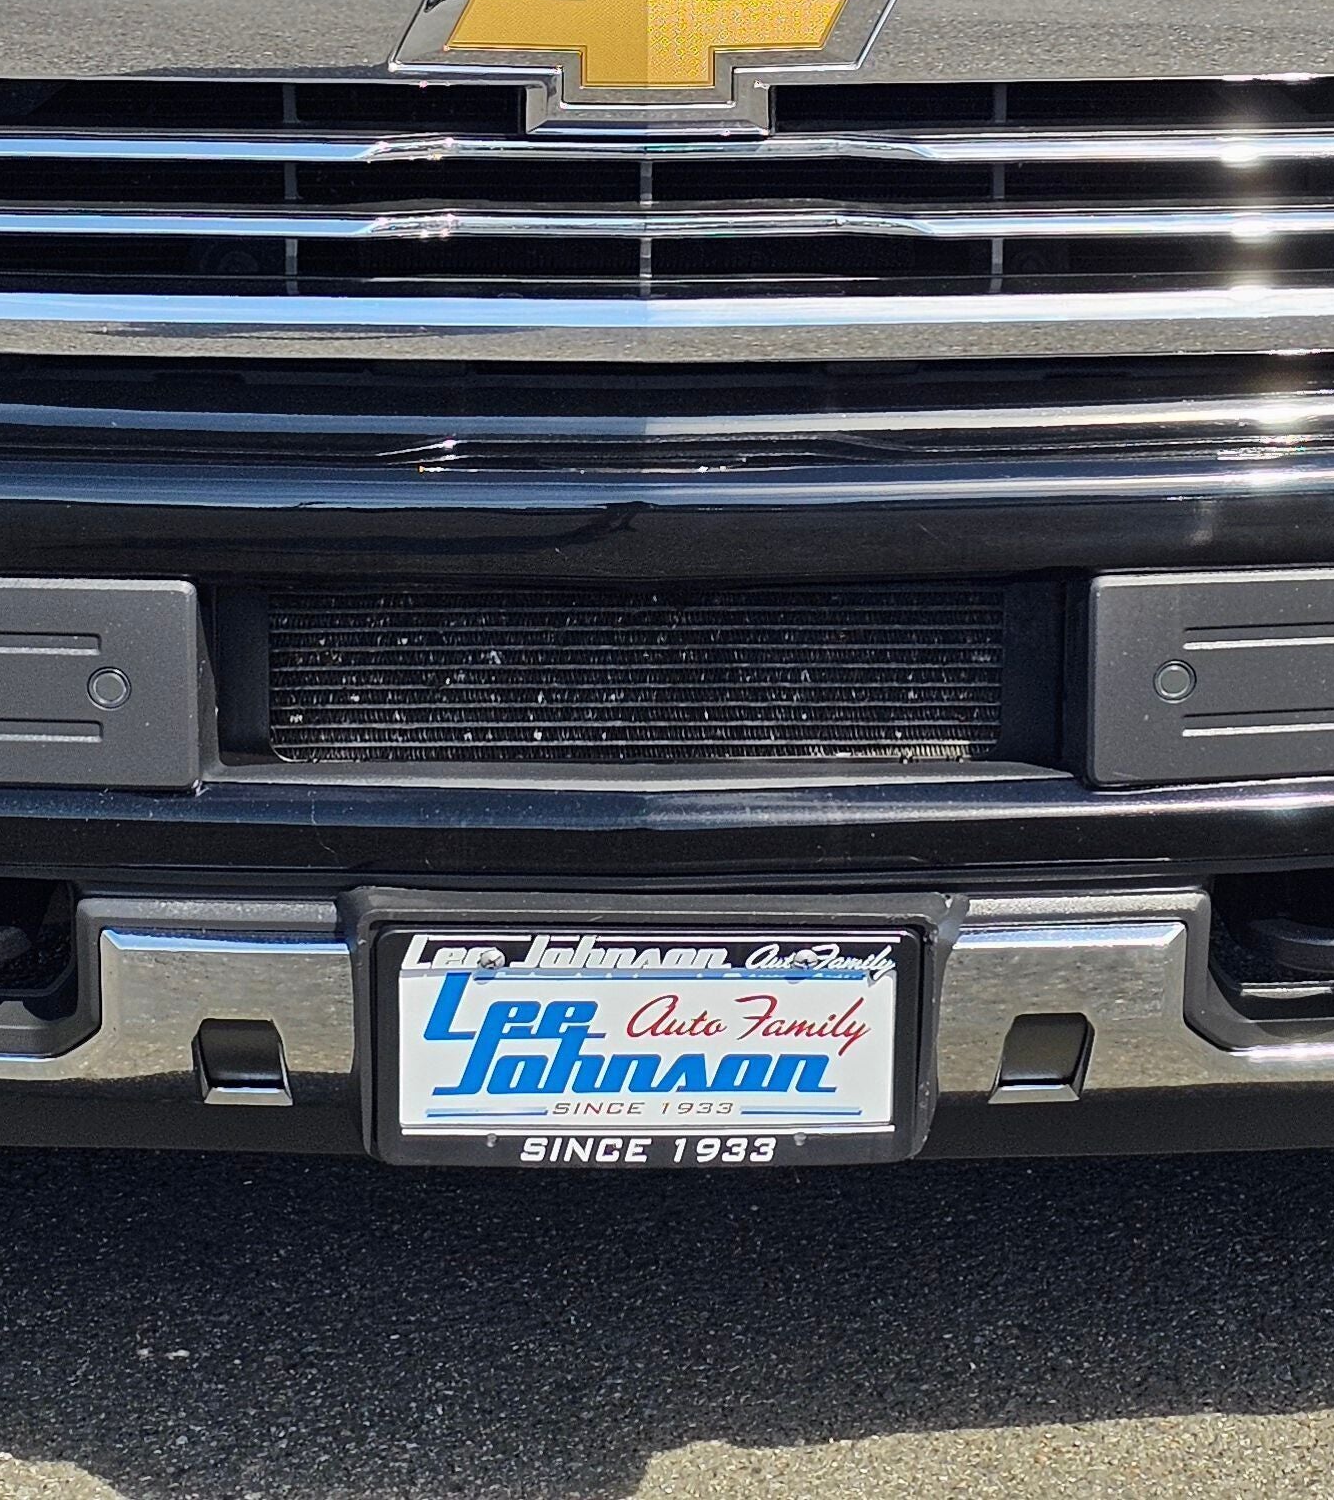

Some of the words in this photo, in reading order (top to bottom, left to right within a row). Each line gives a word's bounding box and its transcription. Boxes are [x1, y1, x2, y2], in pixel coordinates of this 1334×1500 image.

[509, 934, 732, 970] Johnson
[745, 944, 808, 970] Aut
[812, 943, 896, 987] Family
[423, 971, 607, 1041] Lee
[626, 994, 728, 1037] Auto
[734, 994, 872, 1057] Family
[432, 1024, 838, 1097] Johnson
[552, 1101, 646, 1116] SINCE
[661, 1101, 734, 1115] 1933
[520, 1137, 652, 1163] SINCE
[673, 1137, 778, 1163] 1933
